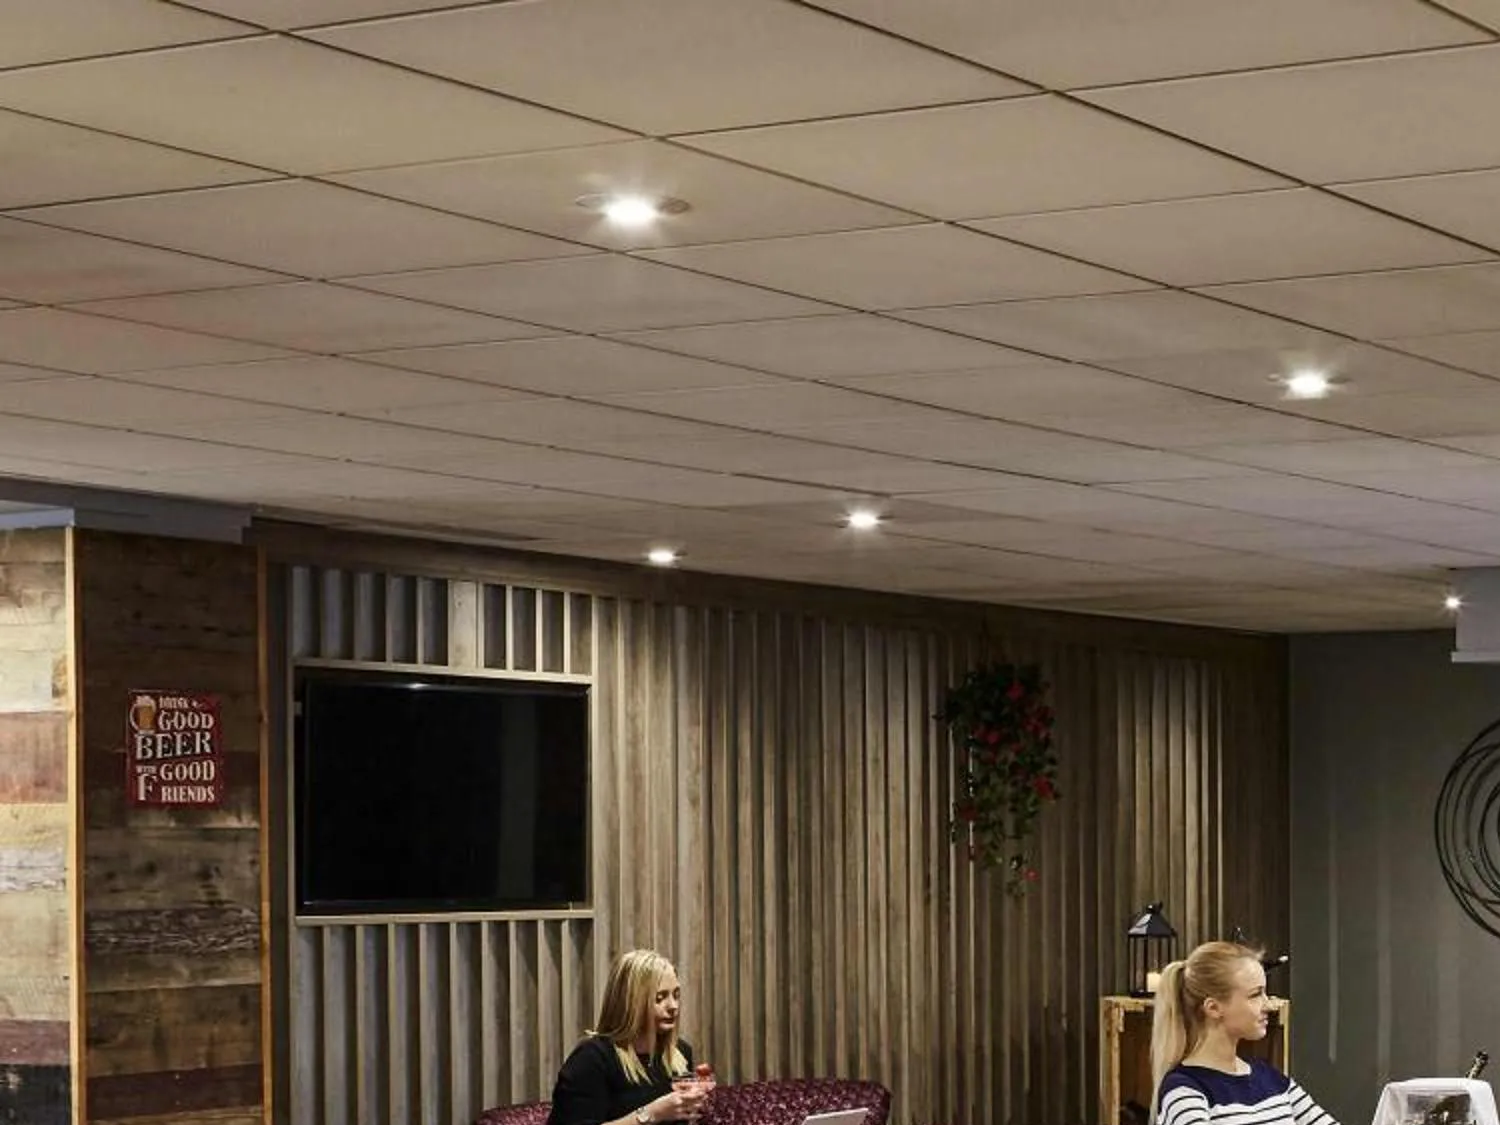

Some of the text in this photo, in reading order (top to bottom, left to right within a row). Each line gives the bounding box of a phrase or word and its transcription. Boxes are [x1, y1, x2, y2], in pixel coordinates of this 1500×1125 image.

[158, 710, 214, 731] GOOD
[134, 731, 212, 760] BEER
[160, 760, 215, 781] GOOD
